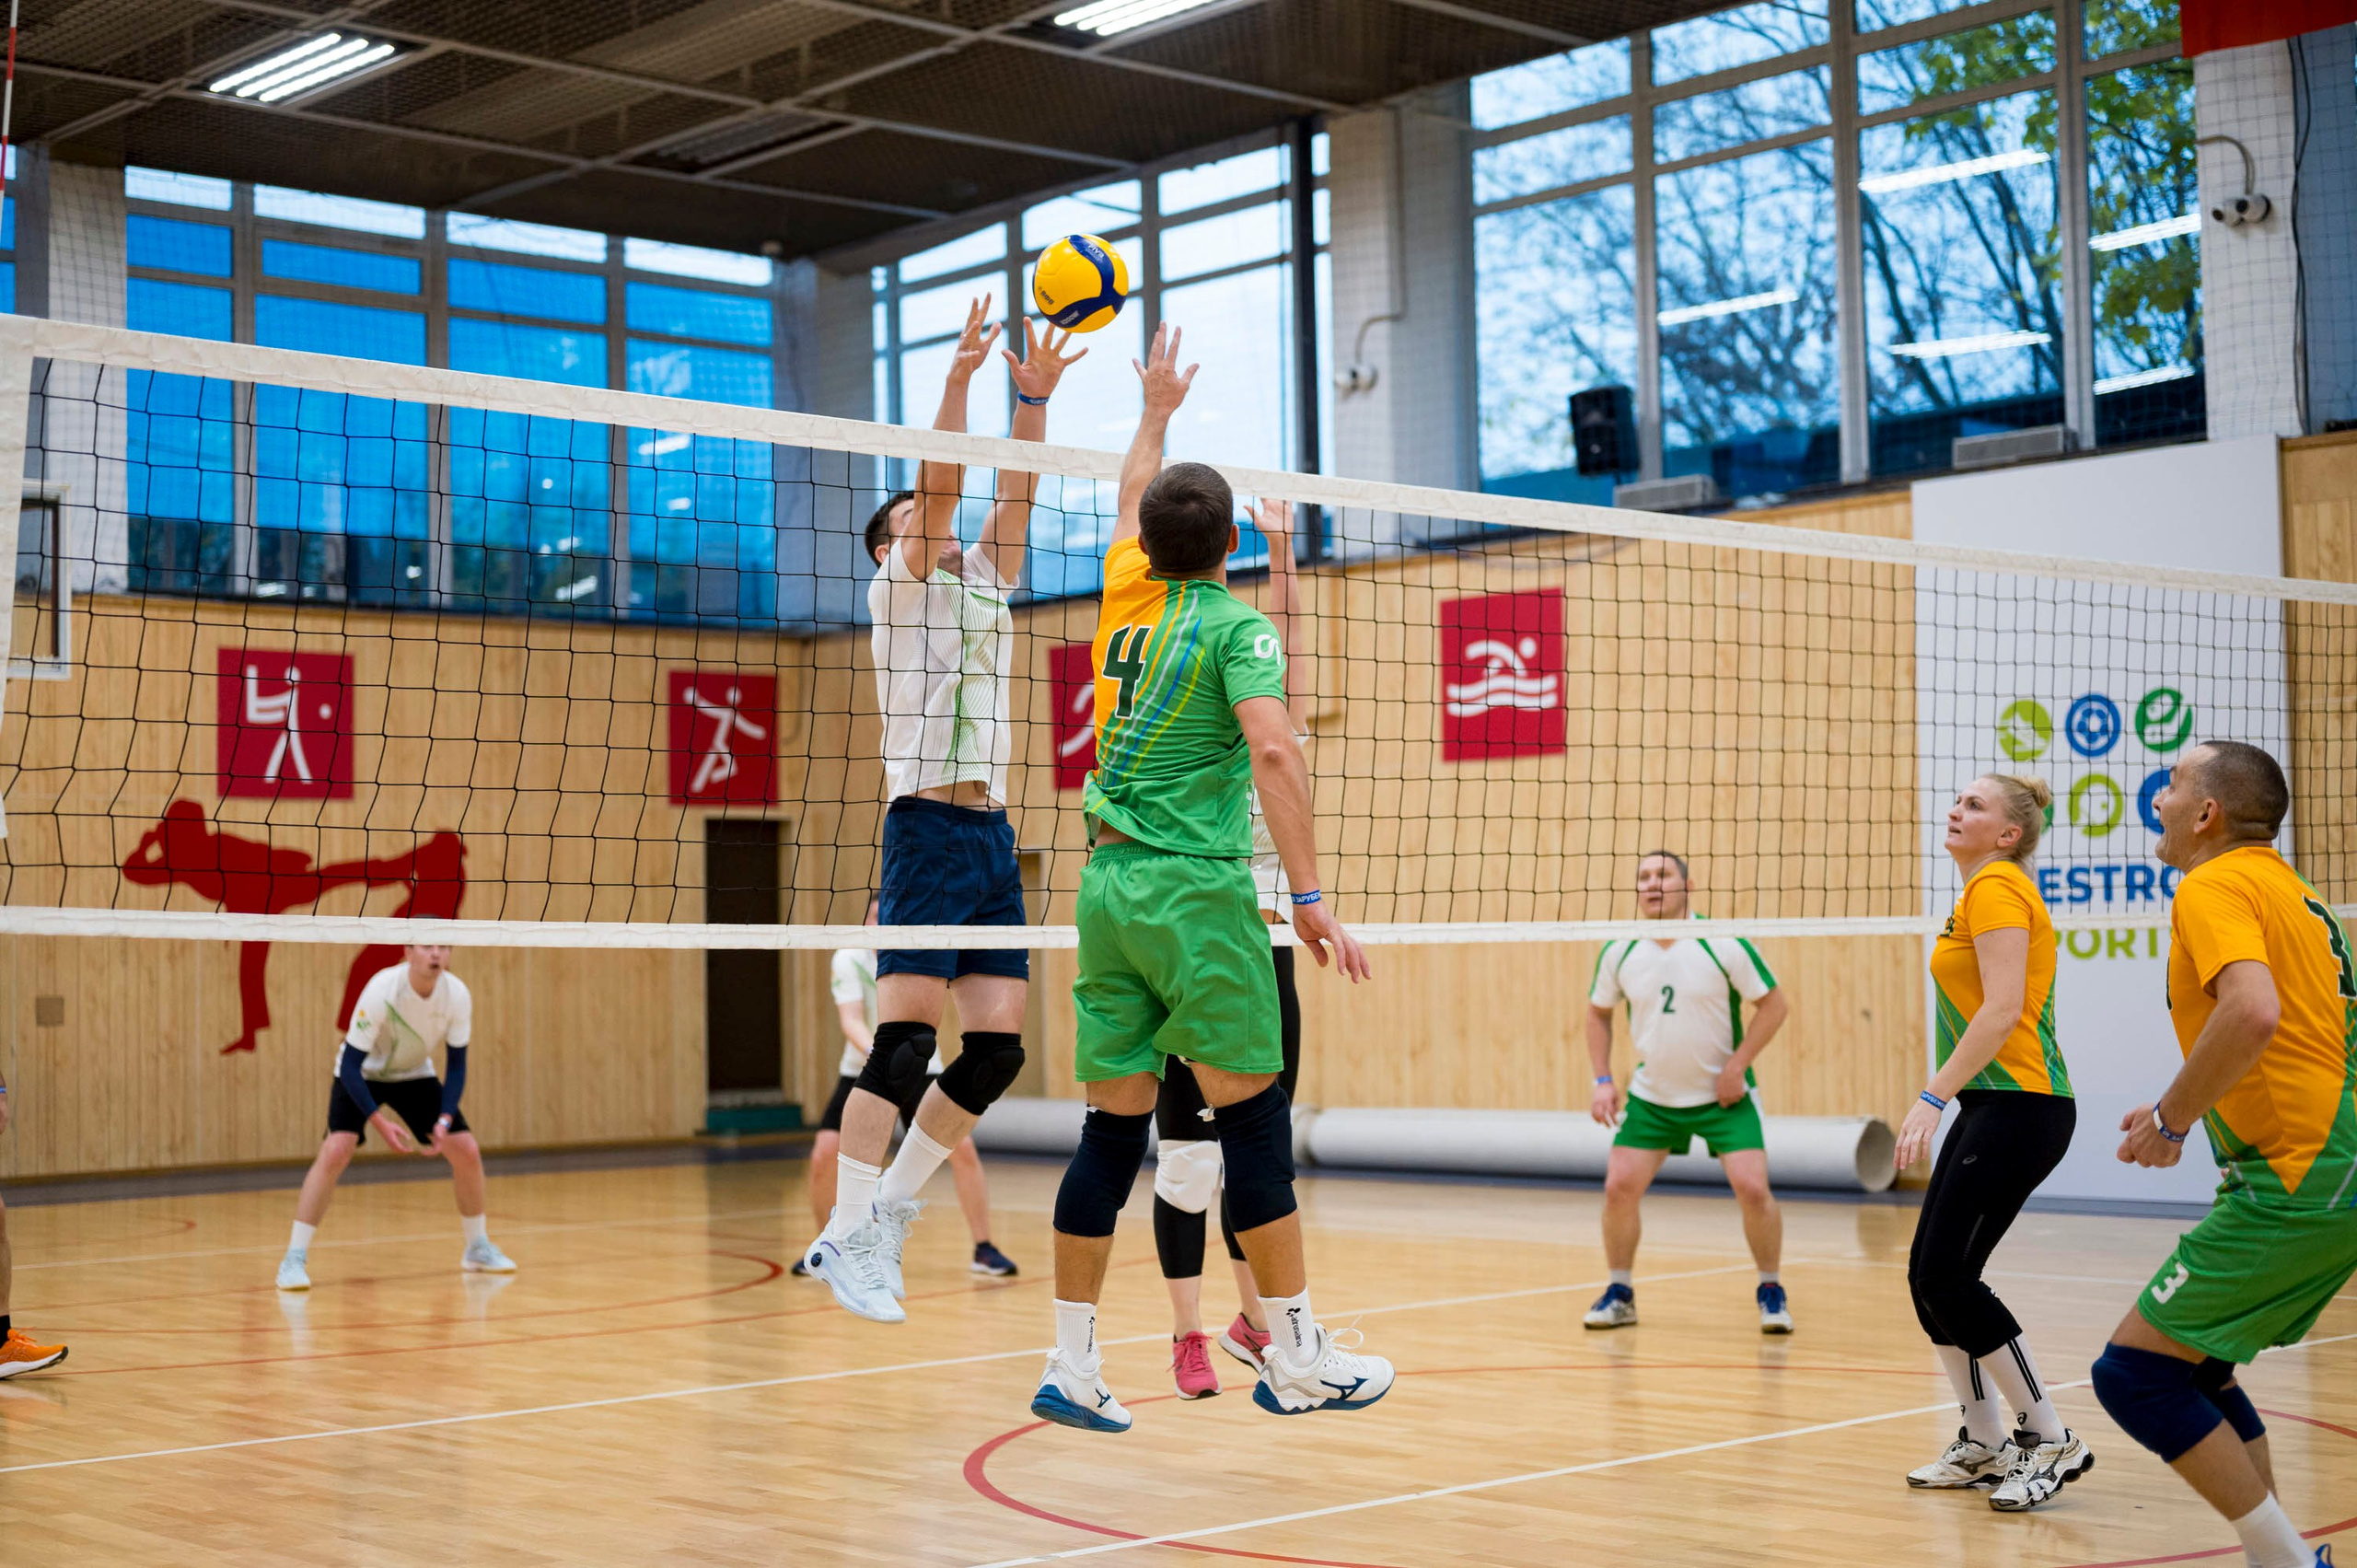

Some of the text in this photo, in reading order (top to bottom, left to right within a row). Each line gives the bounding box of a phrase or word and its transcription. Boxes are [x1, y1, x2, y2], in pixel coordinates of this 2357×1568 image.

[1102, 622, 1154, 720] 4
[2038, 865, 2184, 903] ESTRO
[1661, 985, 1676, 1014] 2
[2151, 1261, 2189, 1304] 3
